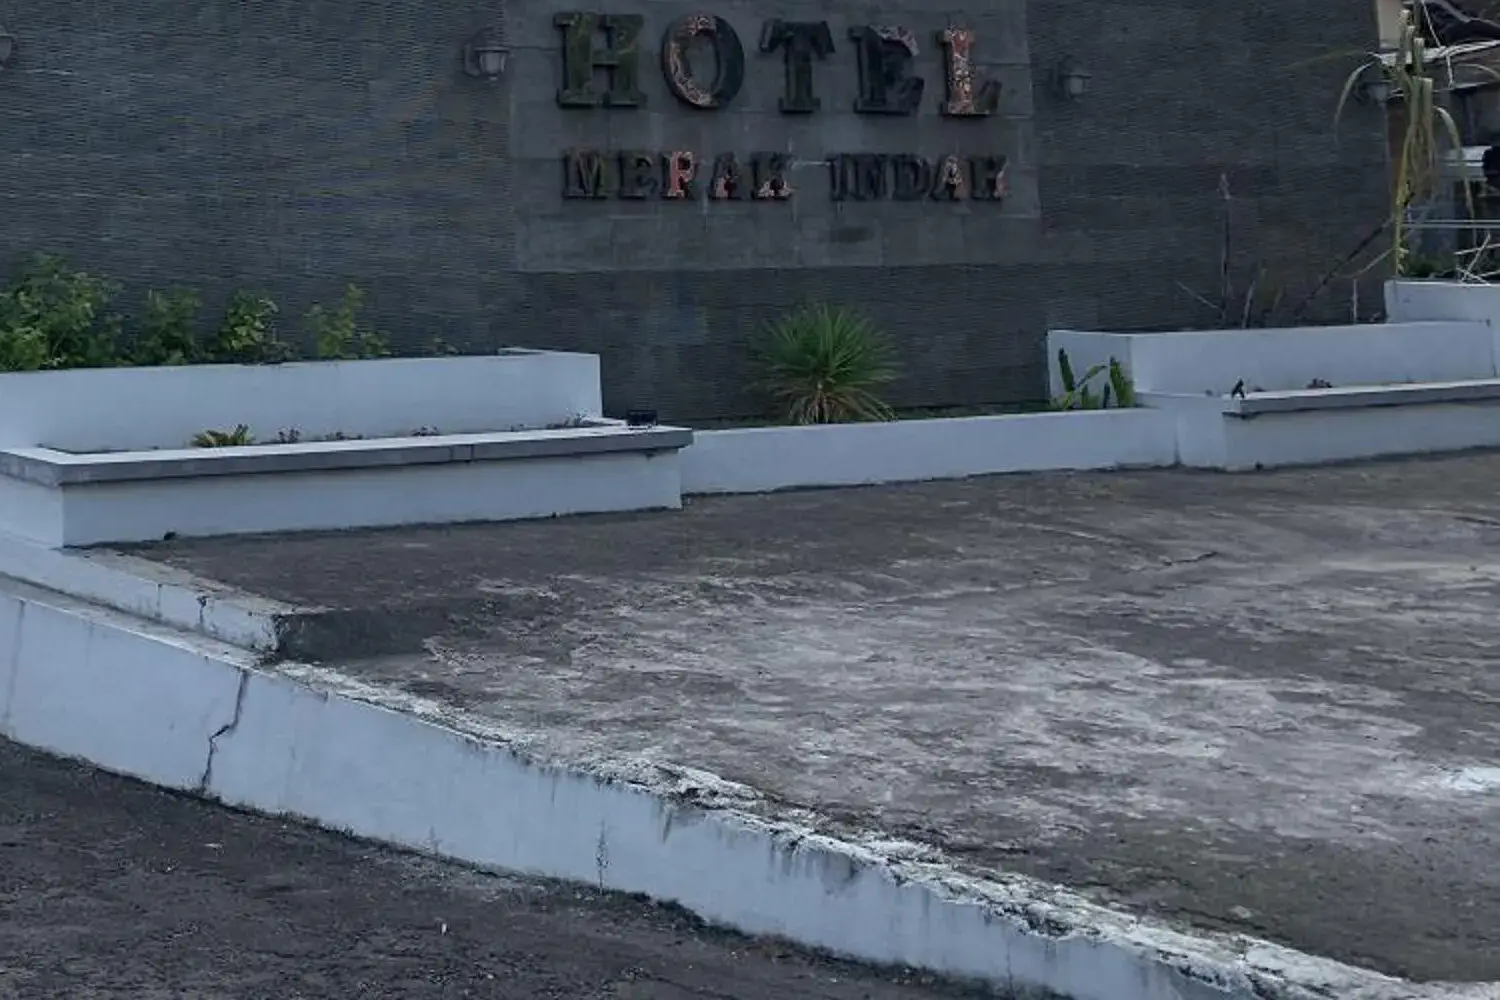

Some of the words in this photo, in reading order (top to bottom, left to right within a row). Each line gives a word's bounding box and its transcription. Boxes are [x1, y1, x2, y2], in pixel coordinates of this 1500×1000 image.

[553, 10, 1003, 117] HOTEL
[561, 146, 794, 201] MERAK
[826, 151, 1010, 202] INDAH
